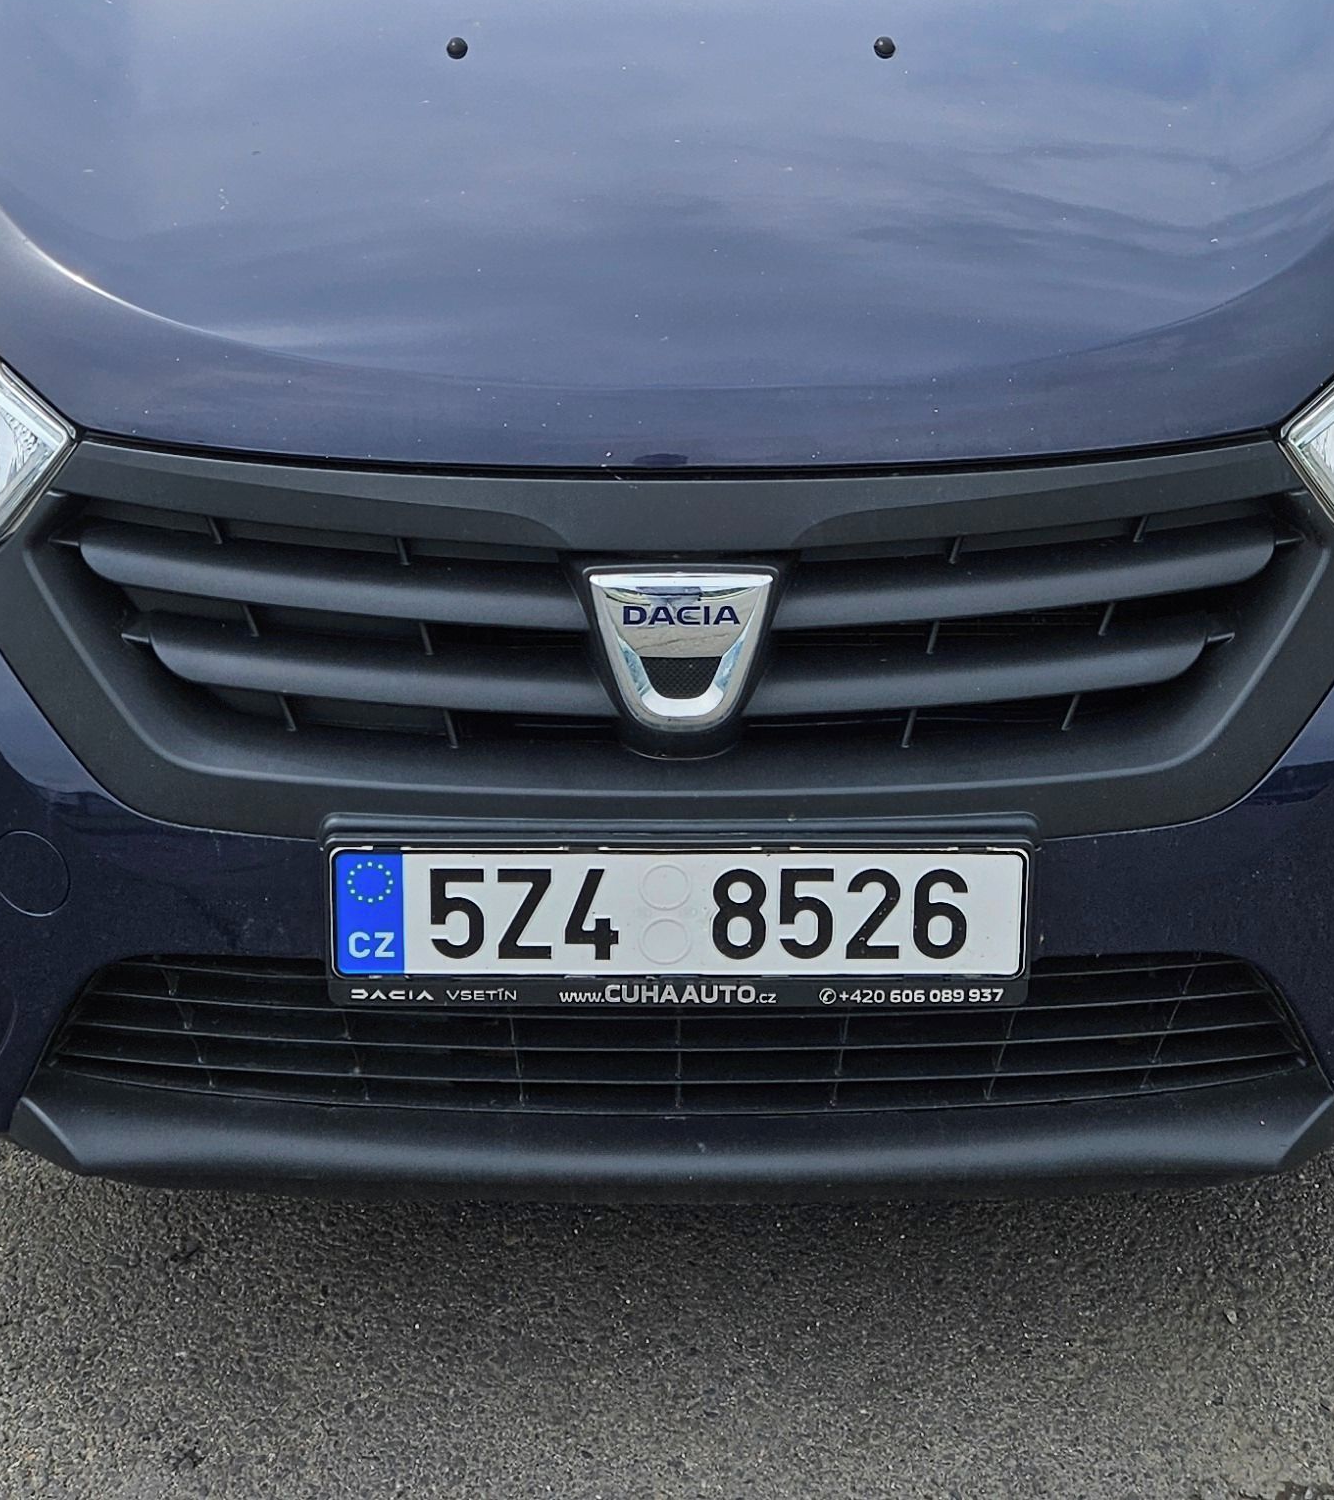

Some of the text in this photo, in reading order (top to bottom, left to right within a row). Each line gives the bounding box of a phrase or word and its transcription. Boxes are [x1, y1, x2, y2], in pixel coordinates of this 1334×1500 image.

[622, 605, 741, 626] DACIA
[429, 868, 970, 961] 5Z4 8526
[348, 932, 396, 958] CZ
[350, 987, 517, 1001] DACIA VSETÍN
[558, 983, 777, 1004] www.CUHAAUTO.cz
[838, 988, 1004, 1003] +420 606 089 937
